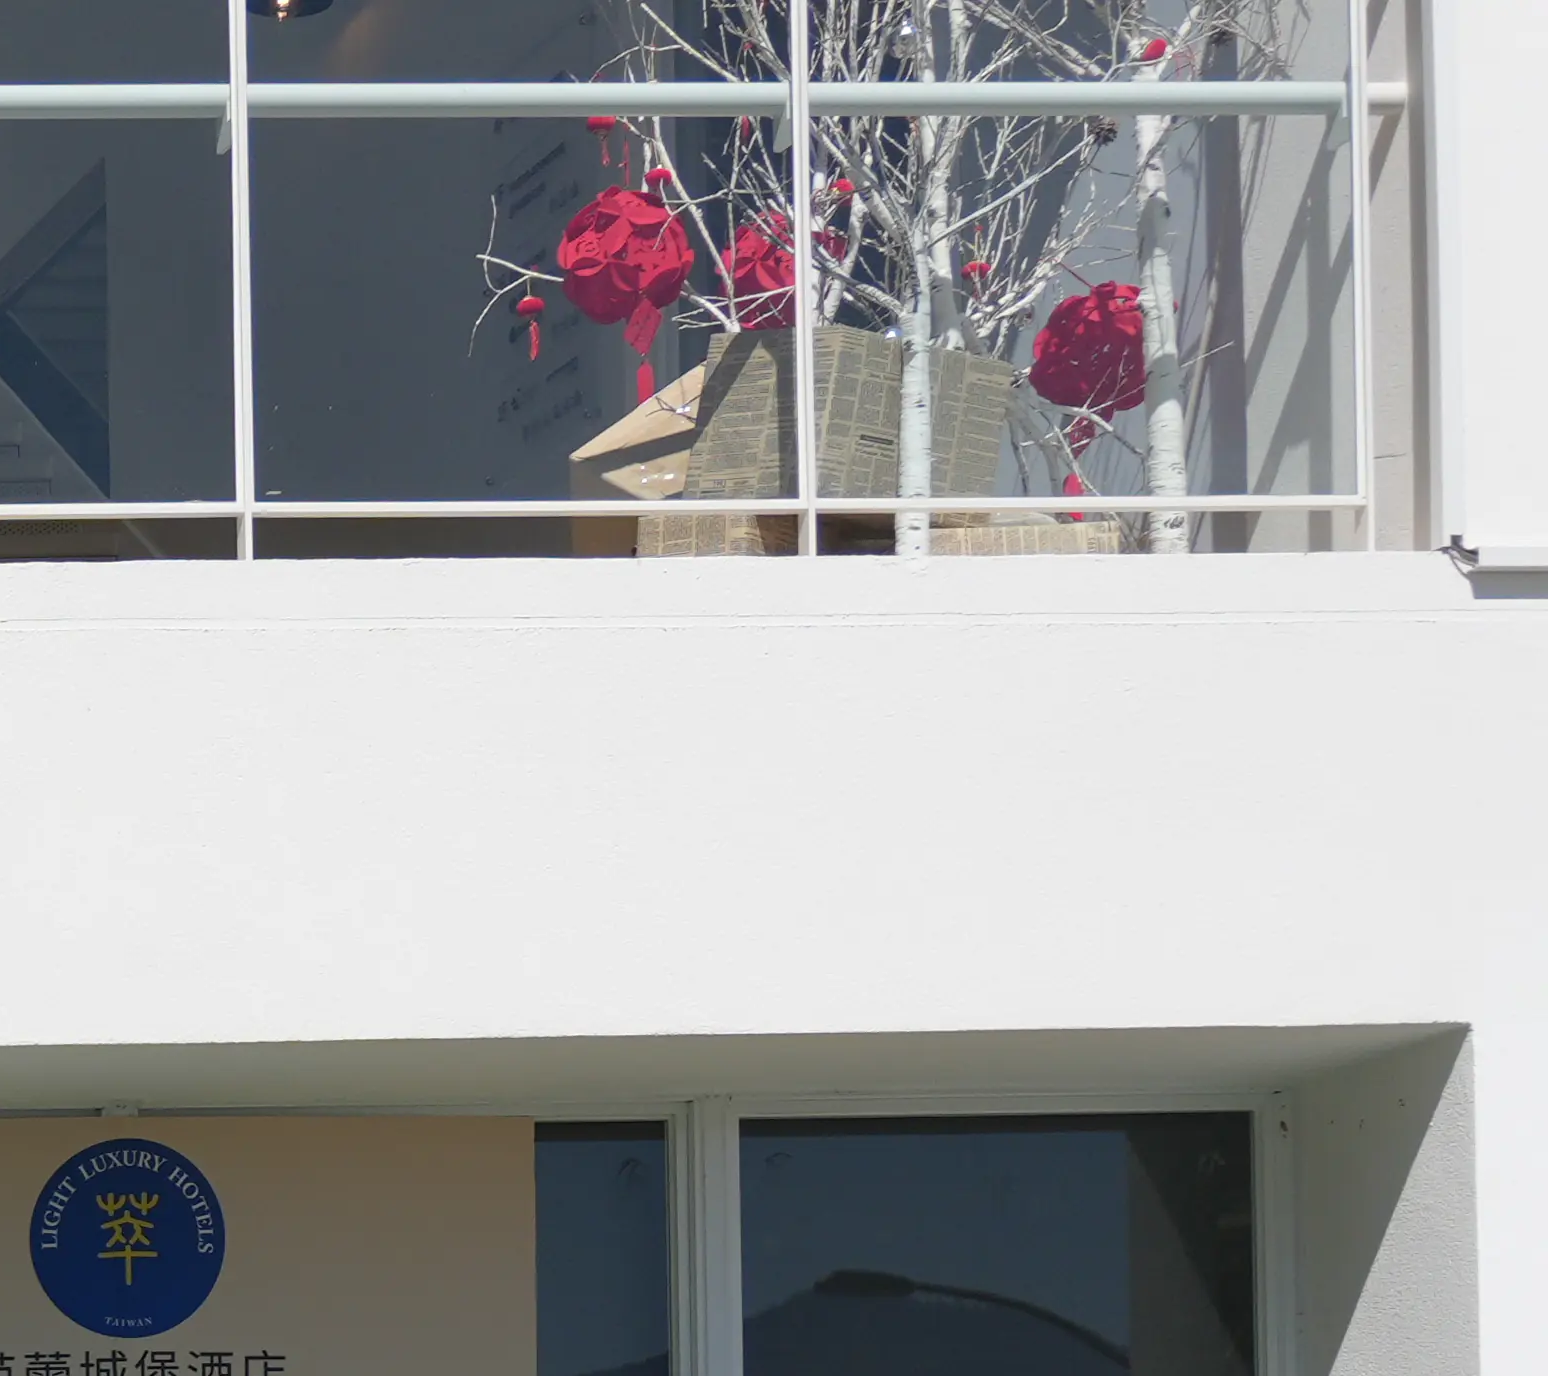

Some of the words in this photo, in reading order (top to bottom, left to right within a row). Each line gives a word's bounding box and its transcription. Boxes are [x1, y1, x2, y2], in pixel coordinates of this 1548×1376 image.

[40, 1175, 77, 1251] LIGHT
[77, 1148, 168, 1182] LUXURY
[167, 1165, 215, 1255] HOTELS
[104, 1316, 154, 1328] TAIWAN
